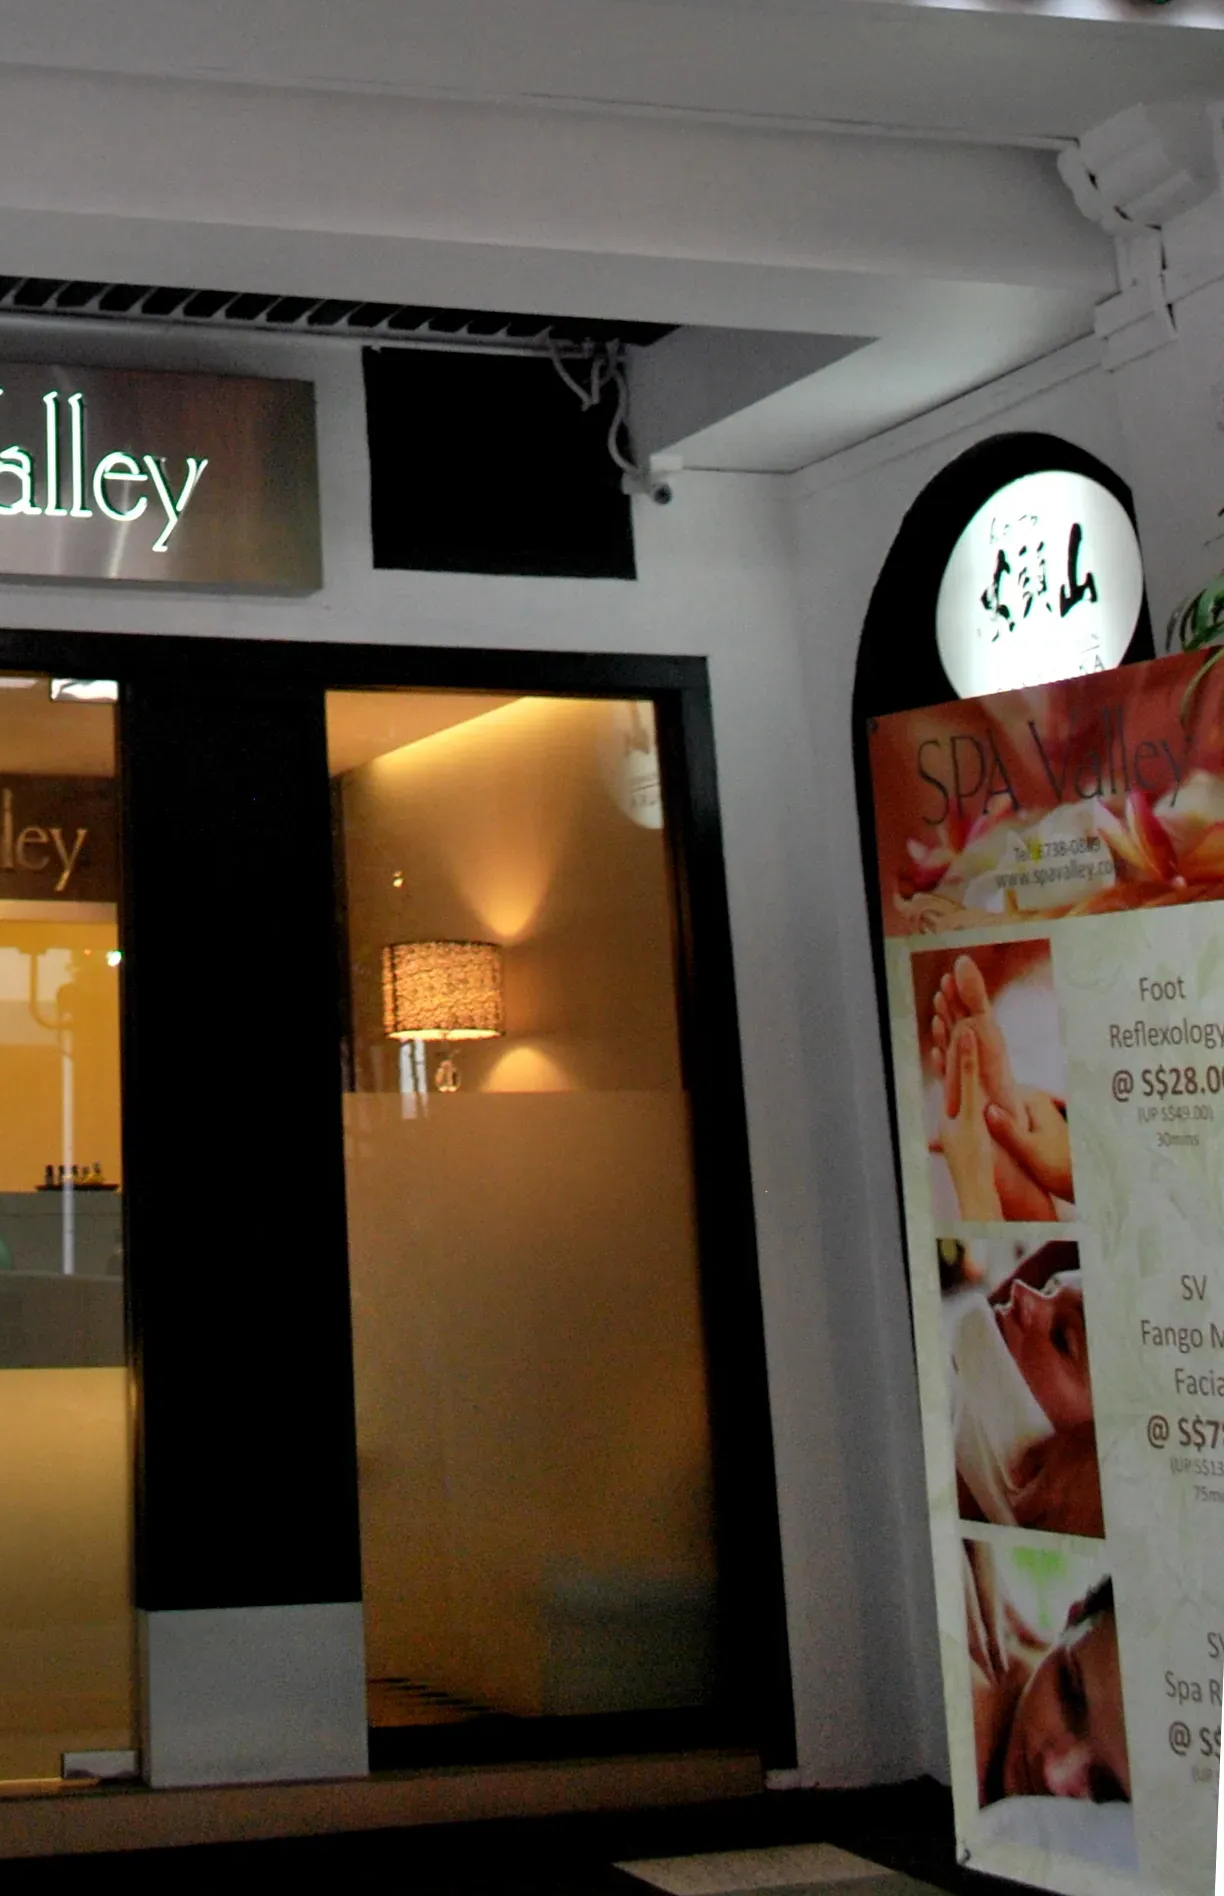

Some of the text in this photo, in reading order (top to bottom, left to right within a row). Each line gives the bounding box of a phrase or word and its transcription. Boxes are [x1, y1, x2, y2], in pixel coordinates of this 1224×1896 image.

[917, 706, 1195, 826] SPA Valley
[1139, 976, 1186, 1002] Foot
[1109, 1018, 1224, 1049] Reflexology
[1112, 1065, 1224, 1102] @ S$28.0
[1181, 1274, 1207, 1301] SV
[1140, 1320, 1204, 1353] Fango
[1147, 1414, 1224, 1452] @ S$7
[1164, 1670, 1202, 1704] Spa
[1169, 1721, 1191, 1756] @
